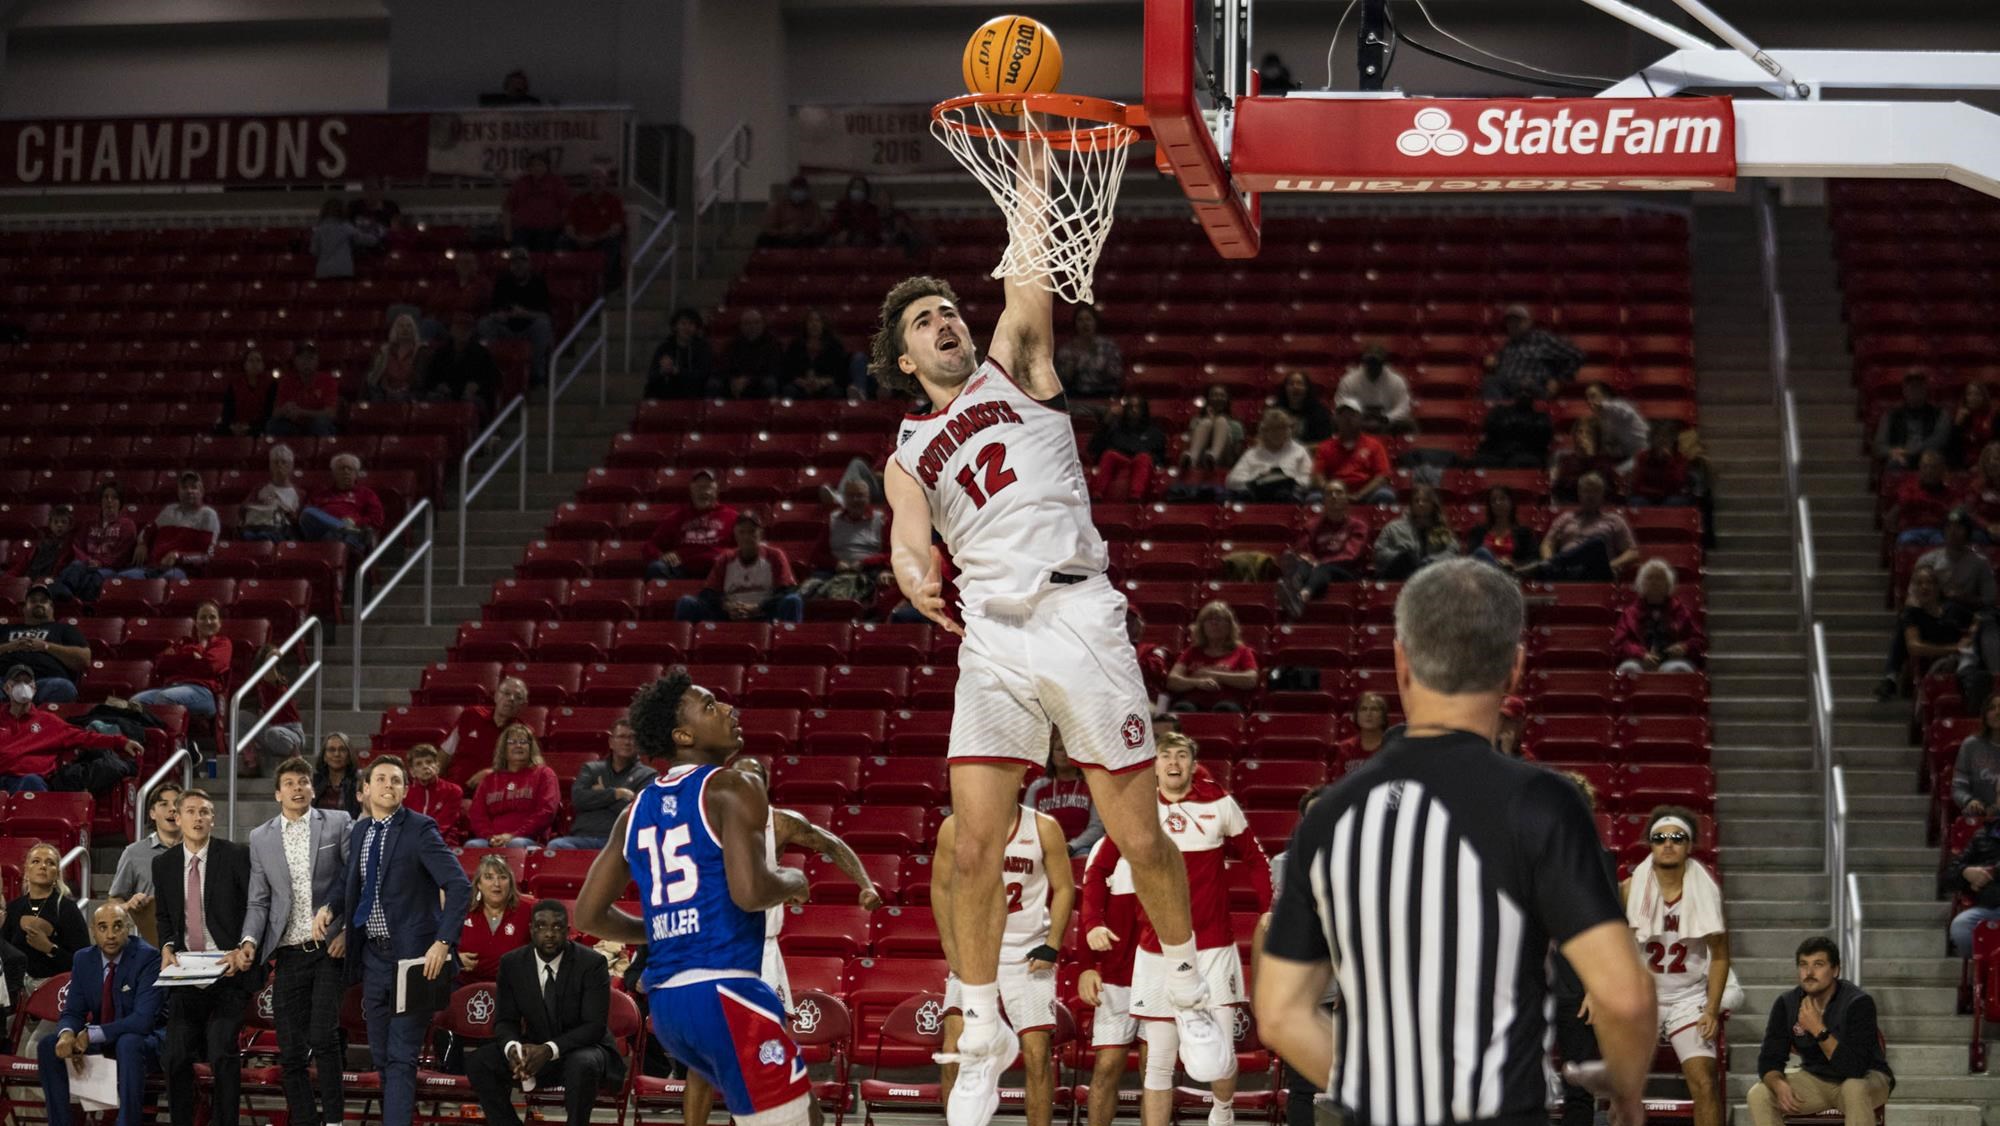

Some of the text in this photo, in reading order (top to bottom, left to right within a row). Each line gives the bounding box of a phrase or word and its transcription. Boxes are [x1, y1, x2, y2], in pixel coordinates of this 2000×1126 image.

[1004, 24, 1036, 84] Wilson
[501, 119, 599, 141] BASKETBALL
[845, 113, 929, 135] VOLLEYBA
[1473, 108, 1721, 156] State Farm
[16, 119, 349, 183] CHAMPIONS
[872, 139, 921, 164] 2016
[916, 400, 1025, 491] SOUTH DAKOTA
[955, 442, 1018, 511] 12
[1062, 794, 1089, 810] DAKOTA
[637, 823, 699, 907] 15
[1004, 856, 1034, 875] AKOTA
[652, 908, 701, 941] MILLER
[1646, 942, 1688, 974] 22
[665, 1084, 686, 1092] COYO
[888, 1088, 920, 1096] COYOTES
[1645, 1103, 1677, 1111] COYOTES
